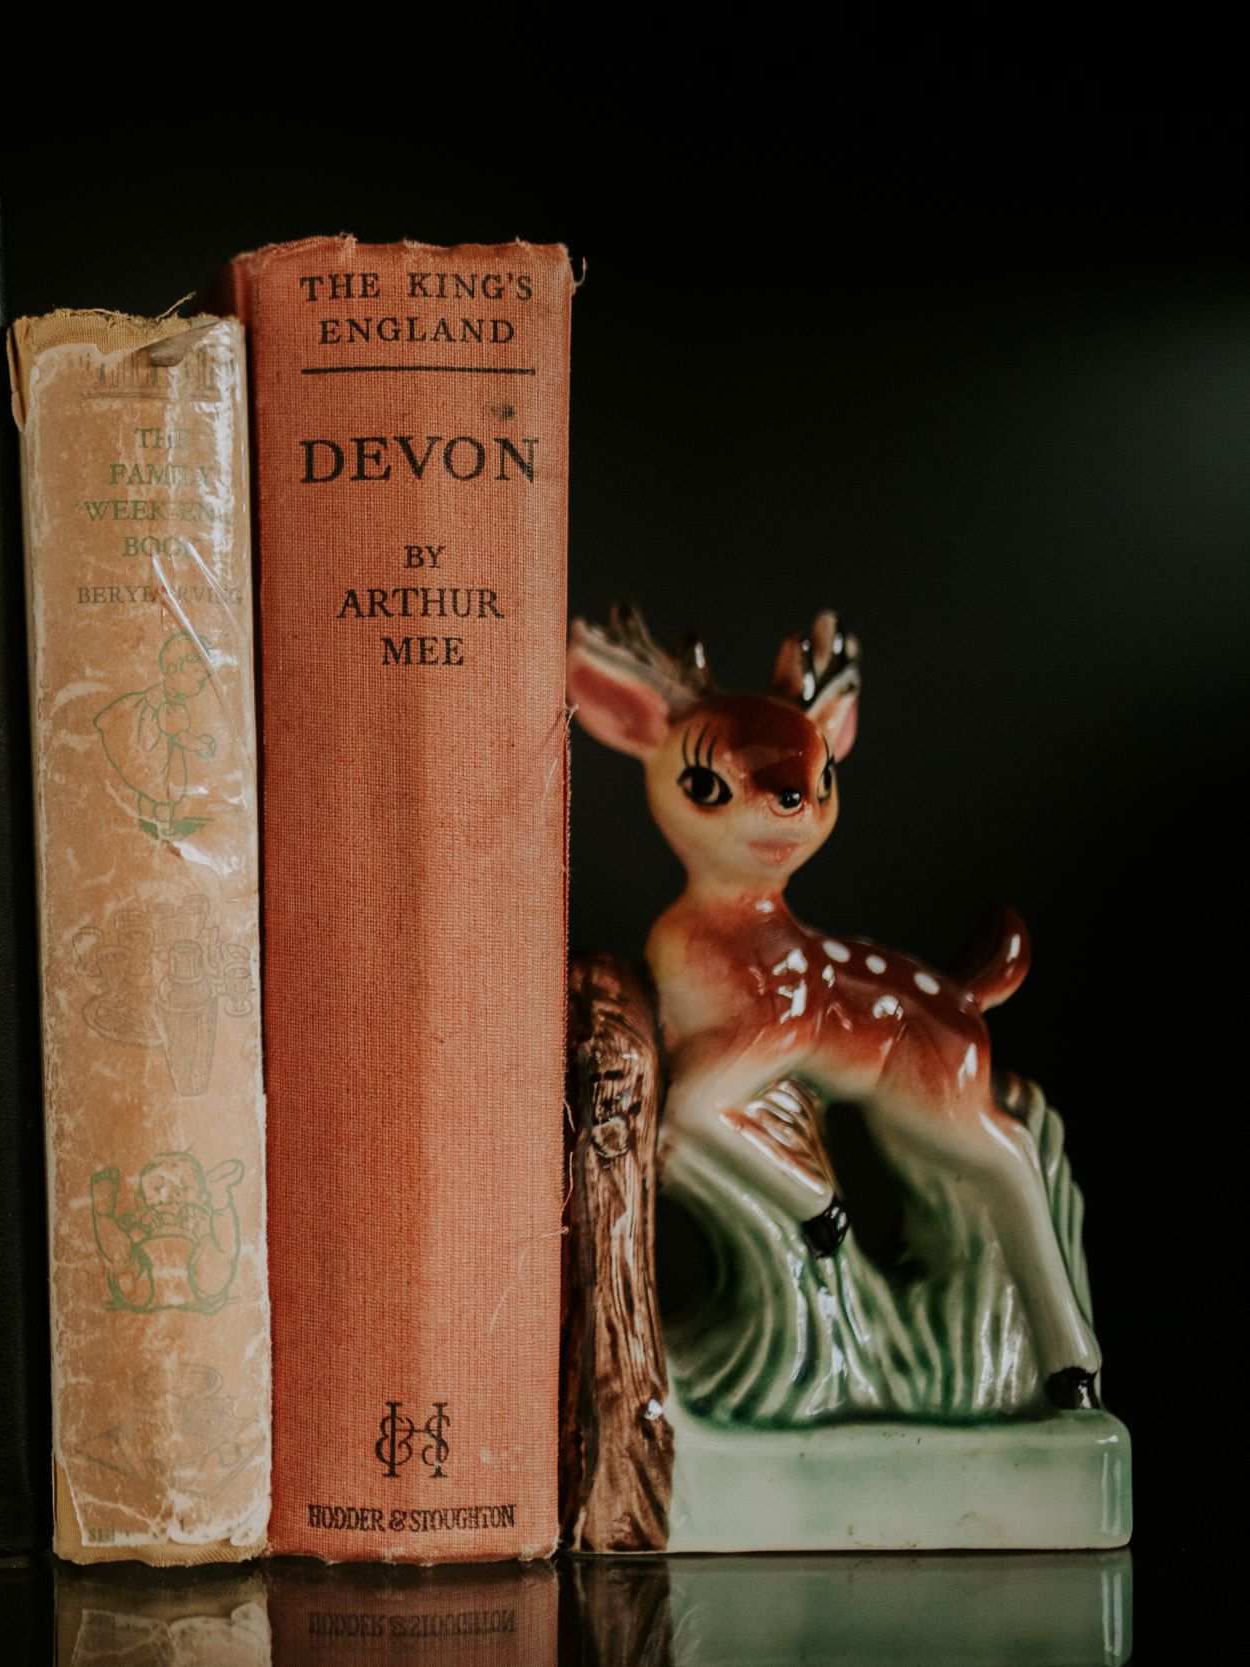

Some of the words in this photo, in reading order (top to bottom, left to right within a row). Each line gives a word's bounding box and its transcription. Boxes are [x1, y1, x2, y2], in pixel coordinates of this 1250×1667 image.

[300, 272, 381, 301] THE
[407, 271, 533, 301] KING'S
[318, 317, 515, 346] ENGLAND
[135, 427, 191, 449] THE
[299, 435, 538, 484] DEVON
[403, 545, 446, 569] BY
[77, 586, 156, 604] BERYL
[337, 588, 505, 619] ARTHUR
[381, 637, 465, 667] MEE
[307, 1504, 386, 1533] HODDER
[388, 1510, 409, 1533] &
[410, 1504, 517, 1533] STOUGHTON
